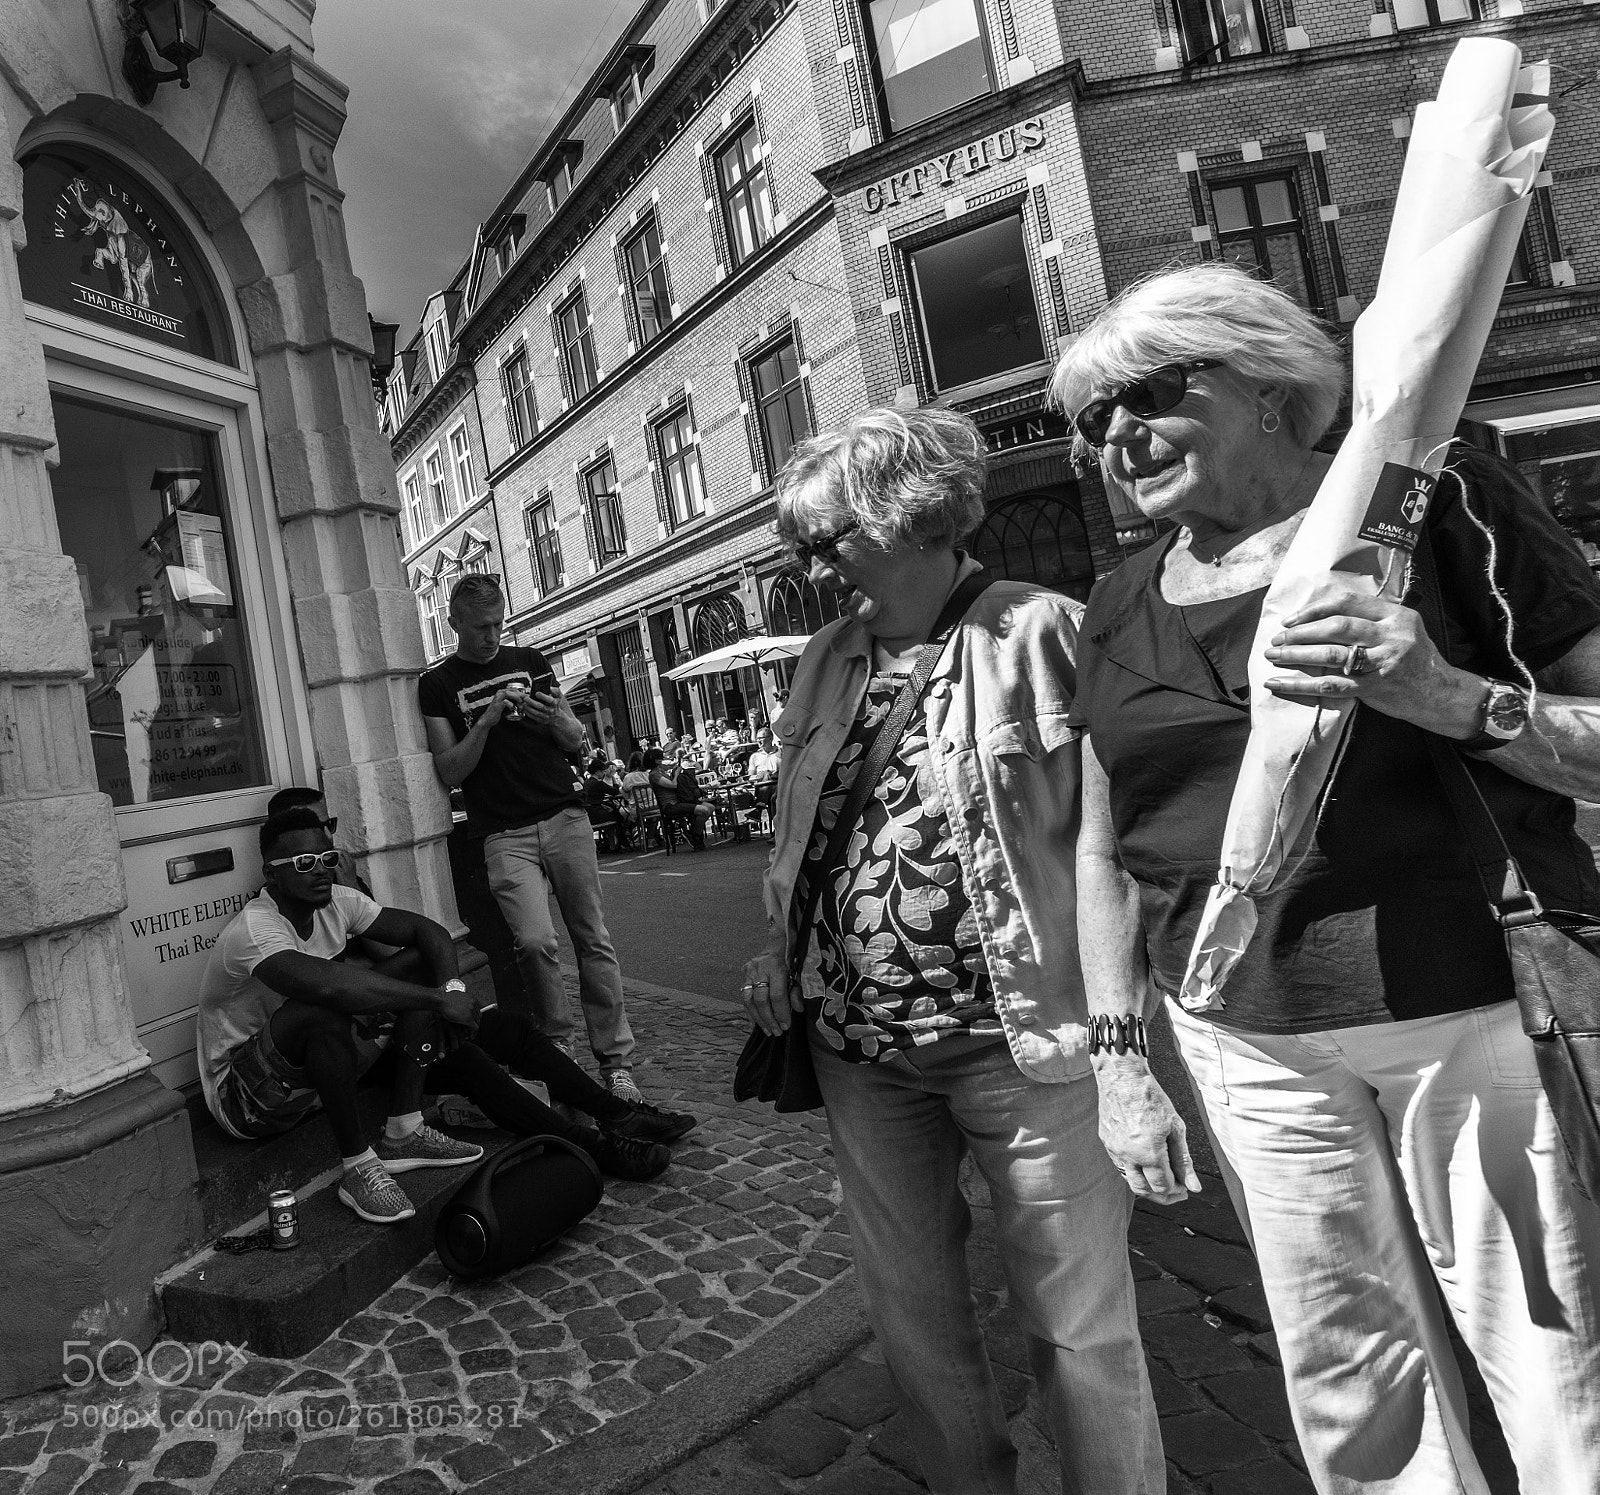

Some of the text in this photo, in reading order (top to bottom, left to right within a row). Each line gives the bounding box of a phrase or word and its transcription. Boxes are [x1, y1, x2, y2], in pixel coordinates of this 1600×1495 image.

[861, 117, 1047, 215] CITYHUS
[55, 178, 89, 239] WHITE
[80, 289, 178, 332] THAI RESTAURANT
[1378, 522, 1406, 536] BANG
[157, 671, 186, 684] 17.00
[156, 725, 172, 740] ud
[155, 748, 170, 762] 86
[172, 747, 186, 760] 12
[203, 744, 217, 757] 99
[129, 907, 192, 939] WHITE
[154, 932, 220, 964] Thai Res
